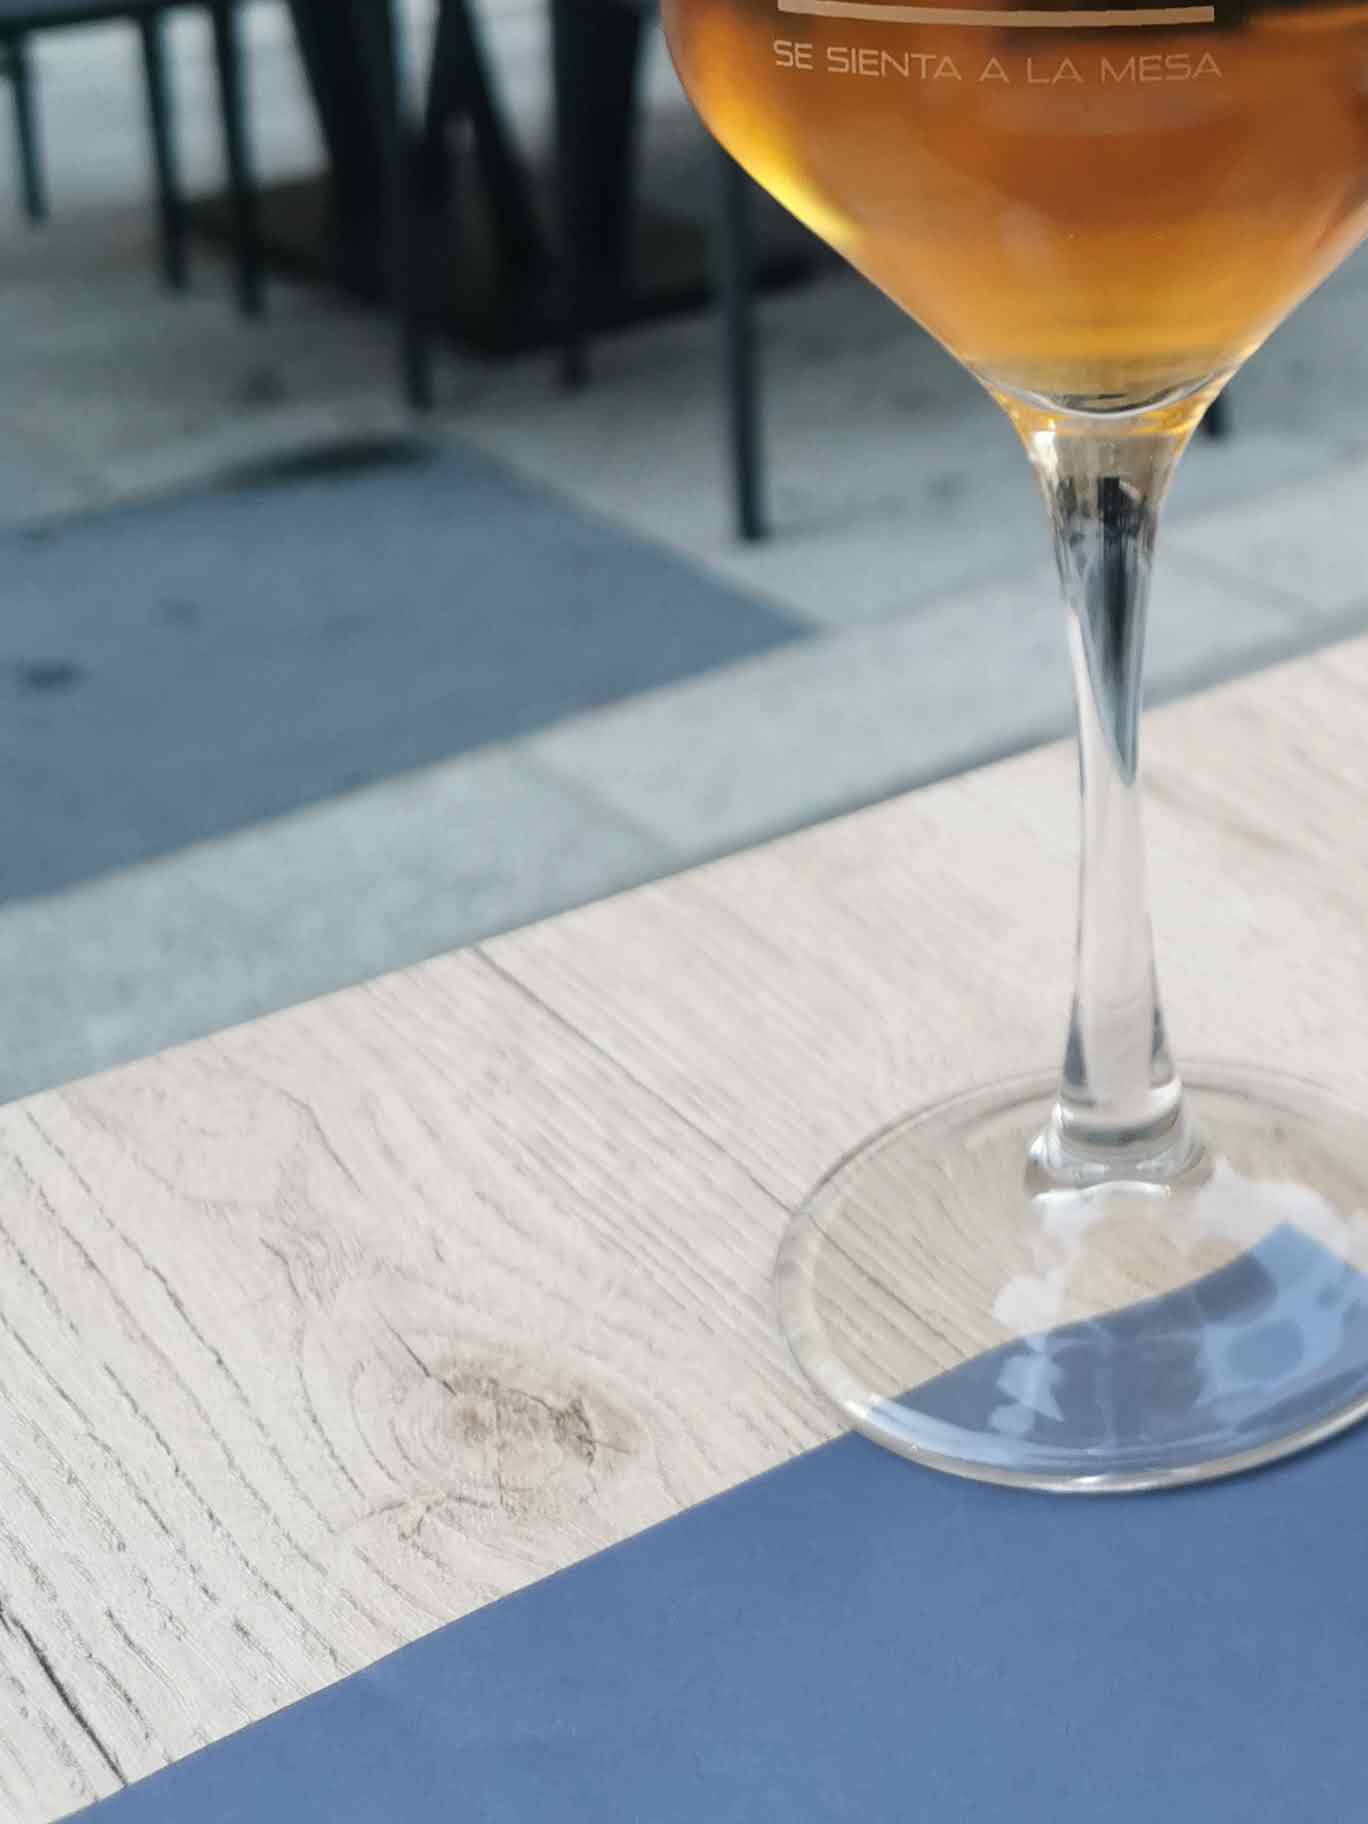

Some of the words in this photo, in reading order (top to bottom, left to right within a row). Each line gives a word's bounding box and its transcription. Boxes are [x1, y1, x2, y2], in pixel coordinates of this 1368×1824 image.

[772, 38, 814, 71] SE
[825, 46, 963, 82] SIENTA
[977, 55, 1010, 84] A
[1026, 56, 1085, 85] LA
[1100, 51, 1224, 85] MESA
